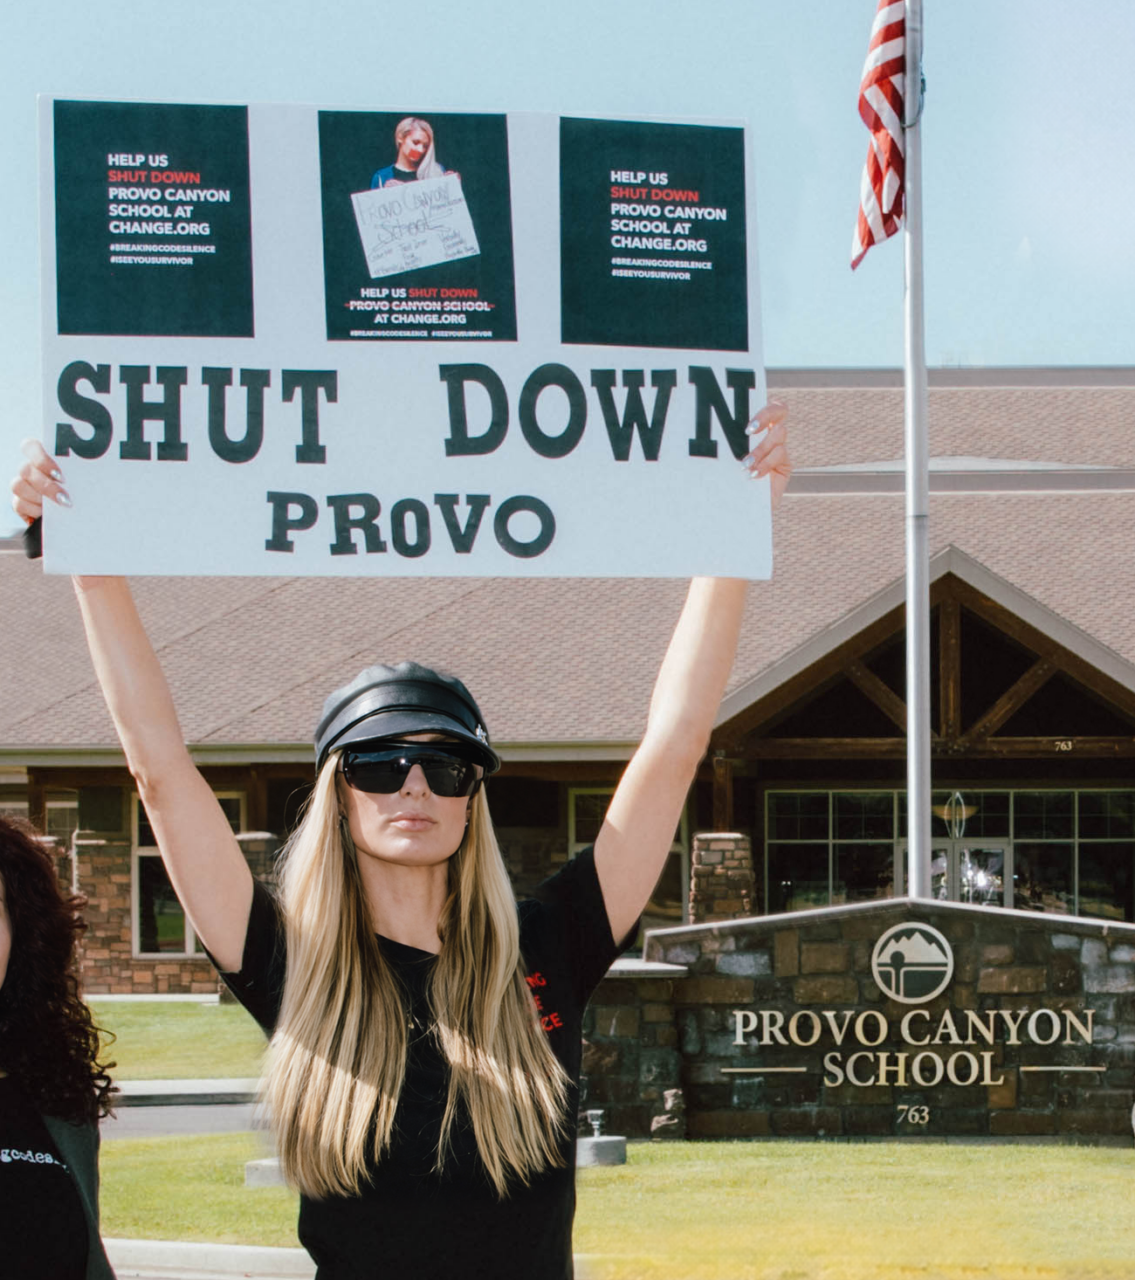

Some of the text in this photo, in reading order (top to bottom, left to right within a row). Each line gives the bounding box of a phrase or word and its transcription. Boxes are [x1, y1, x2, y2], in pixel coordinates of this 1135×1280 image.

[108, 154, 168, 167] HELP US
[108, 170, 200, 183] SHUT DOWN
[610, 171, 668, 185] HELP US
[108, 187, 230, 202] PROVO CANYON
[610, 187, 699, 202] SHUT DOWN
[108, 204, 193, 218] SCHOOL AT
[610, 203, 727, 220] PROVO CANYON
[109, 221, 210, 235] CHANGE.ORG
[610, 219, 691, 234] SCHOOL AT
[109, 244, 215, 253] #BREAKINGCODESILENCE
[611, 236, 707, 252] CHANGE.ORG
[109, 257, 193, 265] #ISEEYOUSURVIVOR
[611, 257, 712, 269] #BREAKINGCODESILENCE
[611, 269, 690, 280] #ISEEYOUSURVIVOR
[361, 288, 478, 298] HELP US SHUT DOWN
[349, 301, 491, 311] PROVO CANYON SCHOOL
[374, 314, 466, 324] AT CHANGE.ORG
[54, 359, 757, 465] SHUT DOWN
[1055, 741, 1073, 751] 763
[731, 1008, 1094, 1047] PROVO CANYON
[823, 1051, 1005, 1088] SCHOOL
[896, 1105, 930, 1125] 763
